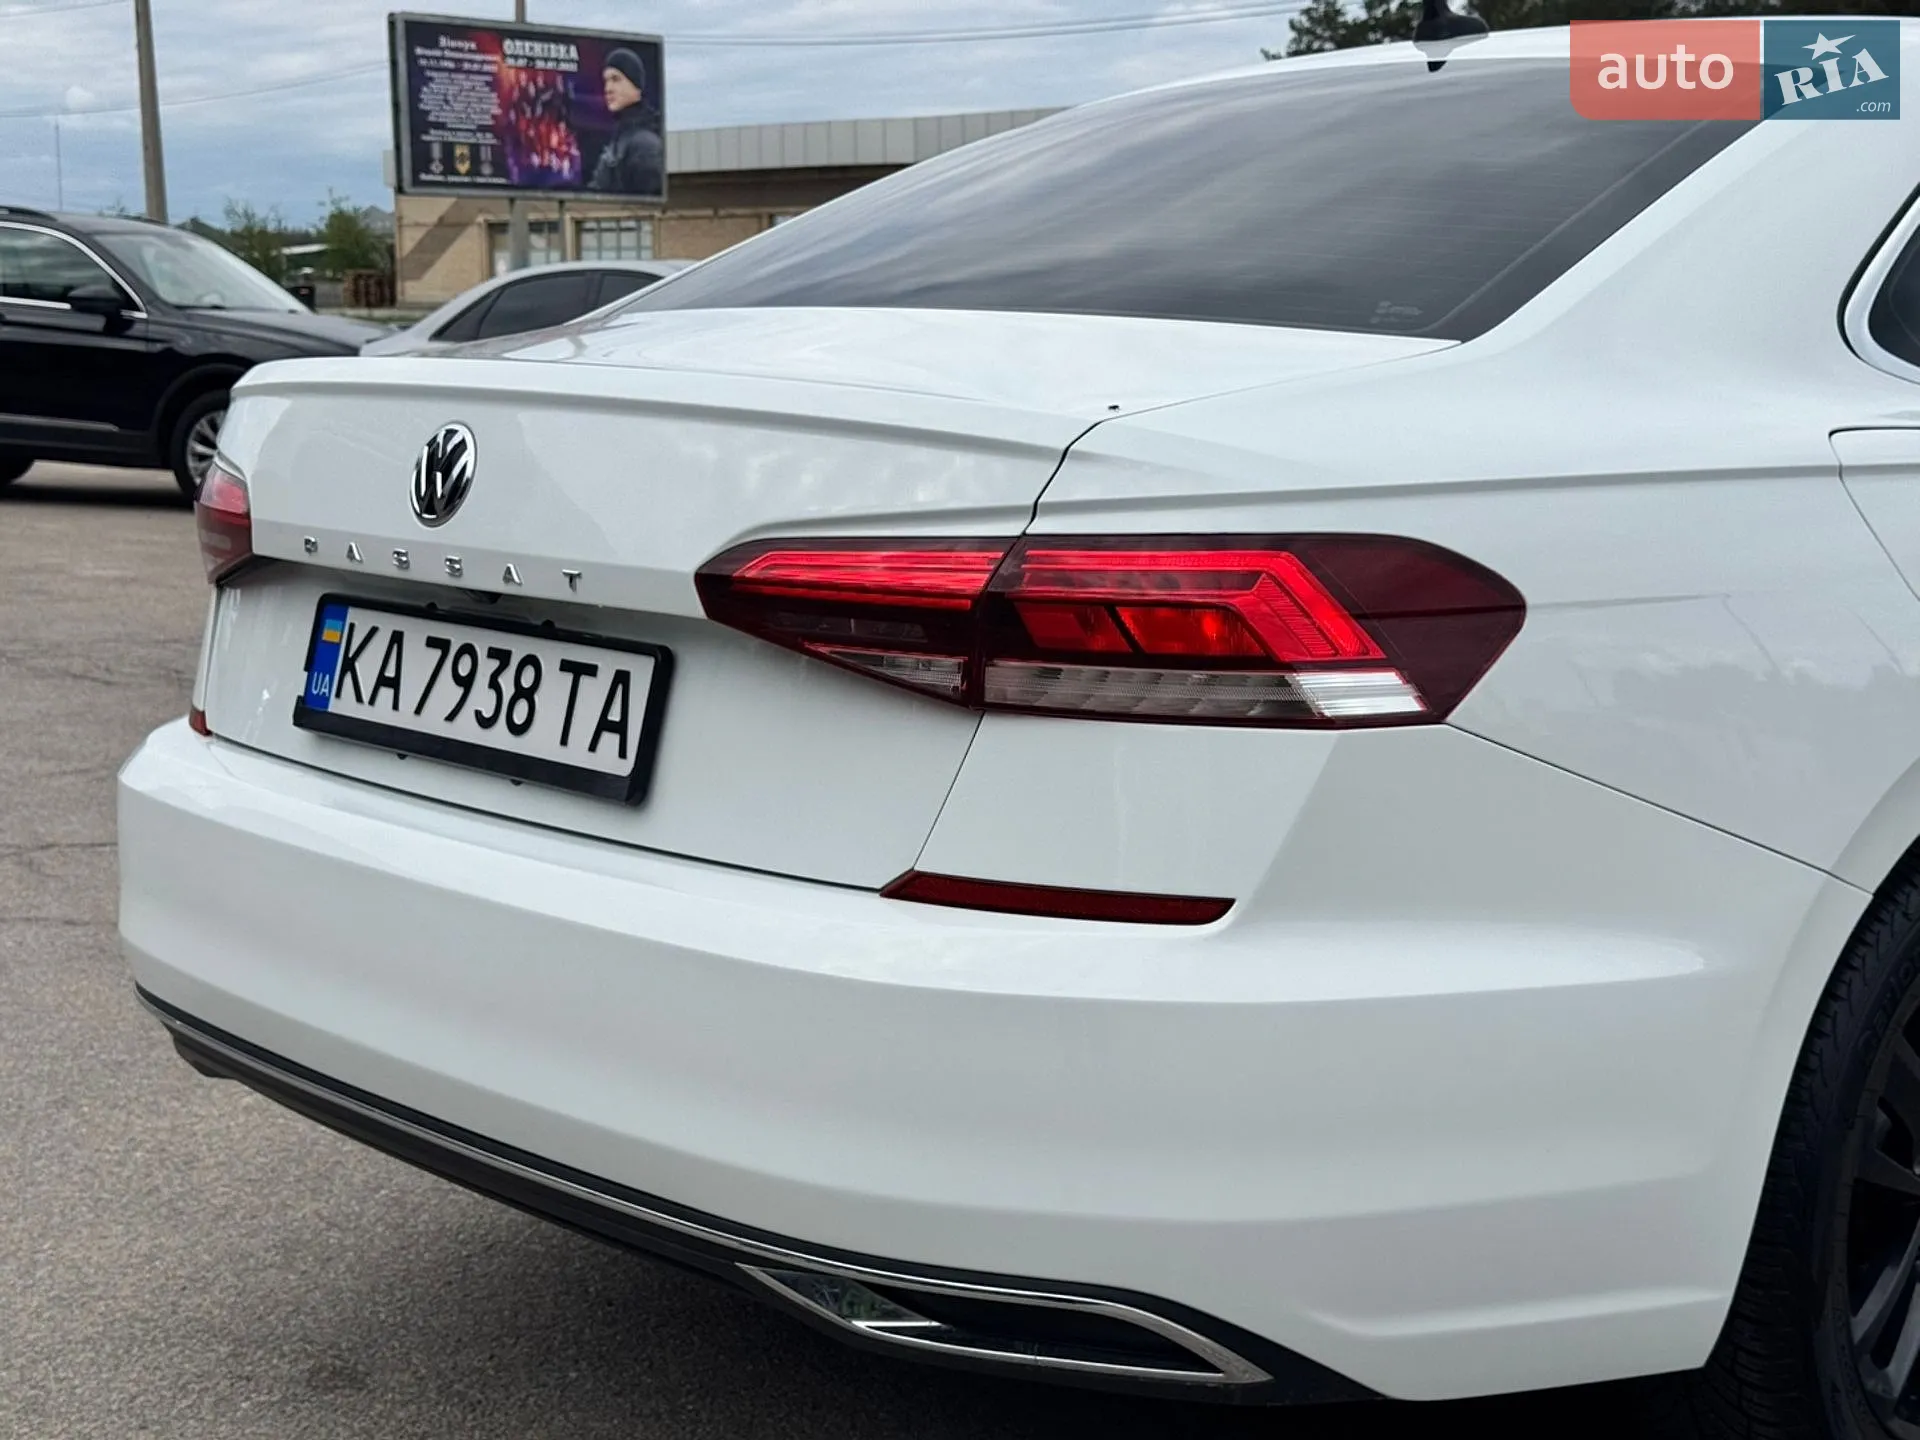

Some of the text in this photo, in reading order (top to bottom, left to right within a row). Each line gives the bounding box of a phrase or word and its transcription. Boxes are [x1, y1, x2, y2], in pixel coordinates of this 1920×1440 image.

[304, 536, 582, 592] PASSAT
[310, 673, 330, 698] UA
[335, 622, 631, 759] KA 7938 TA
